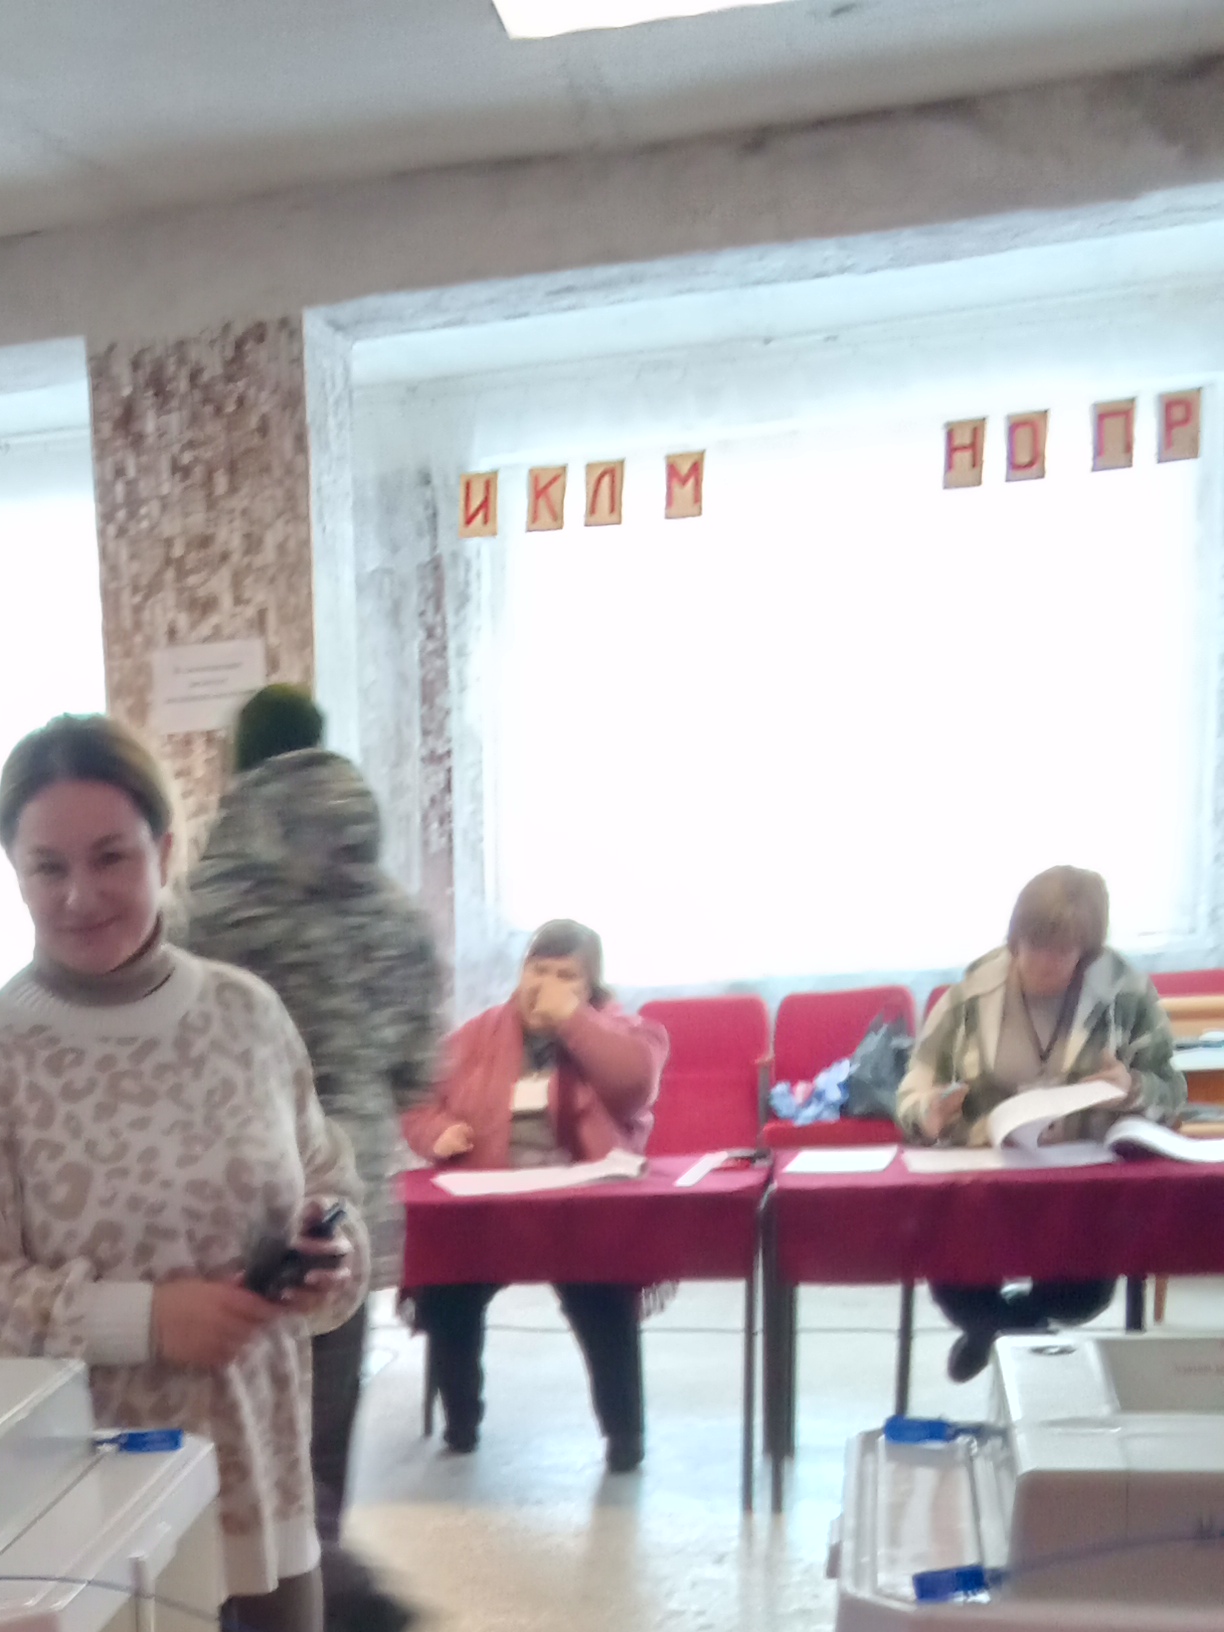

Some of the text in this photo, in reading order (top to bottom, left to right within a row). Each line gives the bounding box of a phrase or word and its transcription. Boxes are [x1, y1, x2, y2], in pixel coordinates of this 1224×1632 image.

[946, 400, 1194, 473] Н О П Р
[464, 461, 702, 527] И К Л М
